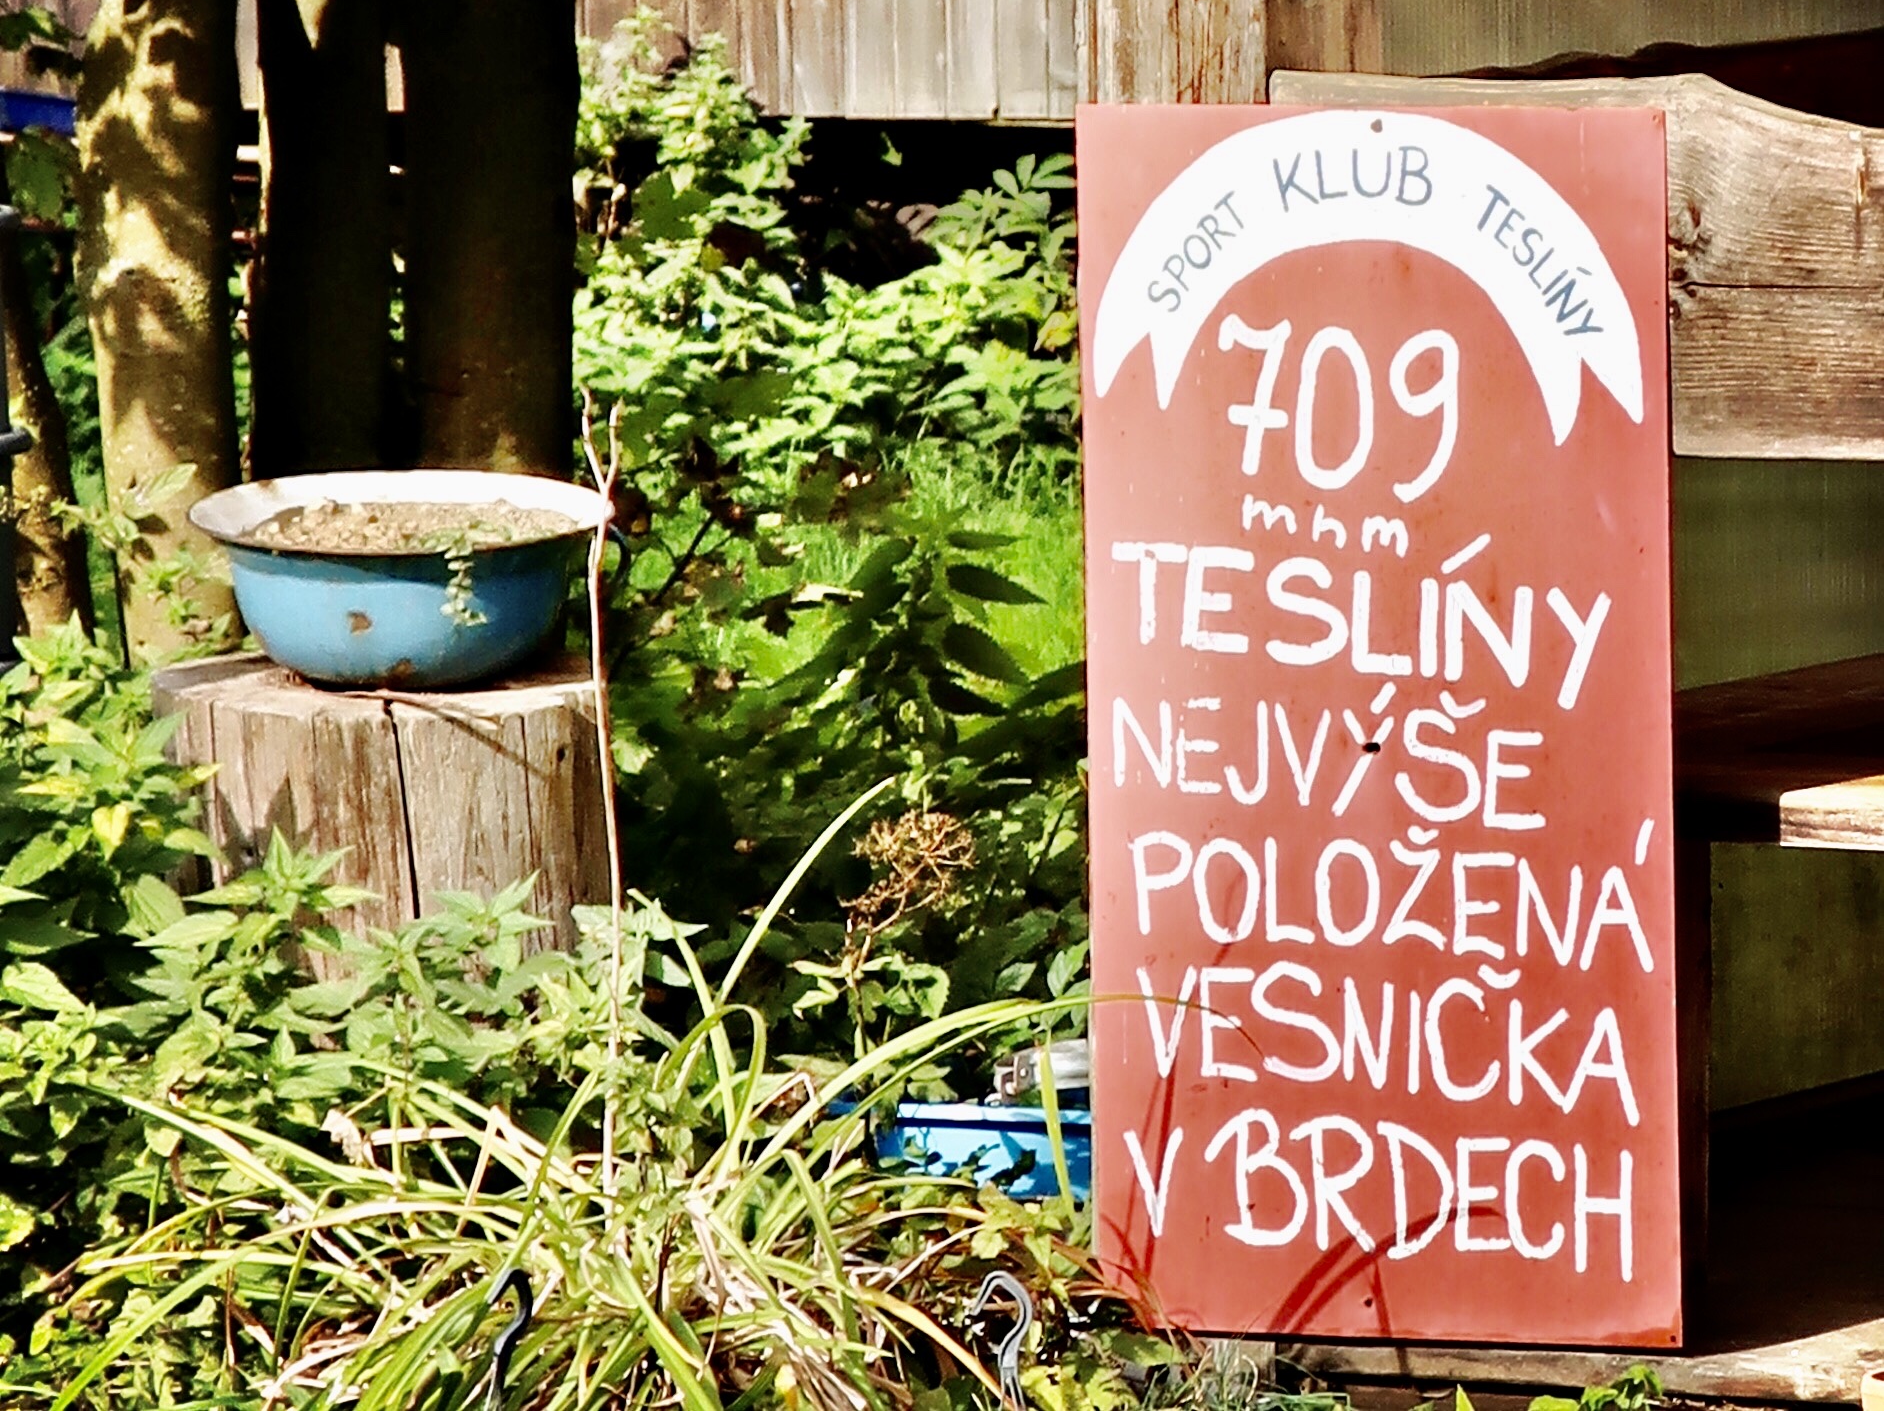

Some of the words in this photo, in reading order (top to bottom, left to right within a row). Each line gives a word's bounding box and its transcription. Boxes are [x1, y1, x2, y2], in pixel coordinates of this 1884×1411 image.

[1148, 191, 1247, 312] SPORT
[1273, 146, 1432, 212] KLUB
[1474, 184, 1603, 338] TESLÍNY
[1217, 313, 1459, 503] 709
[1111, 533, 1613, 710] TESLÍNY
[1112, 681, 1546, 831] NEJVÝŠE
[1129, 818, 1656, 973] POLOŽENÁ
[1136, 961, 1641, 1127] VESNIČKA
[1123, 1126, 1184, 1239] V
[1203, 1107, 1634, 1283] BRDECH
